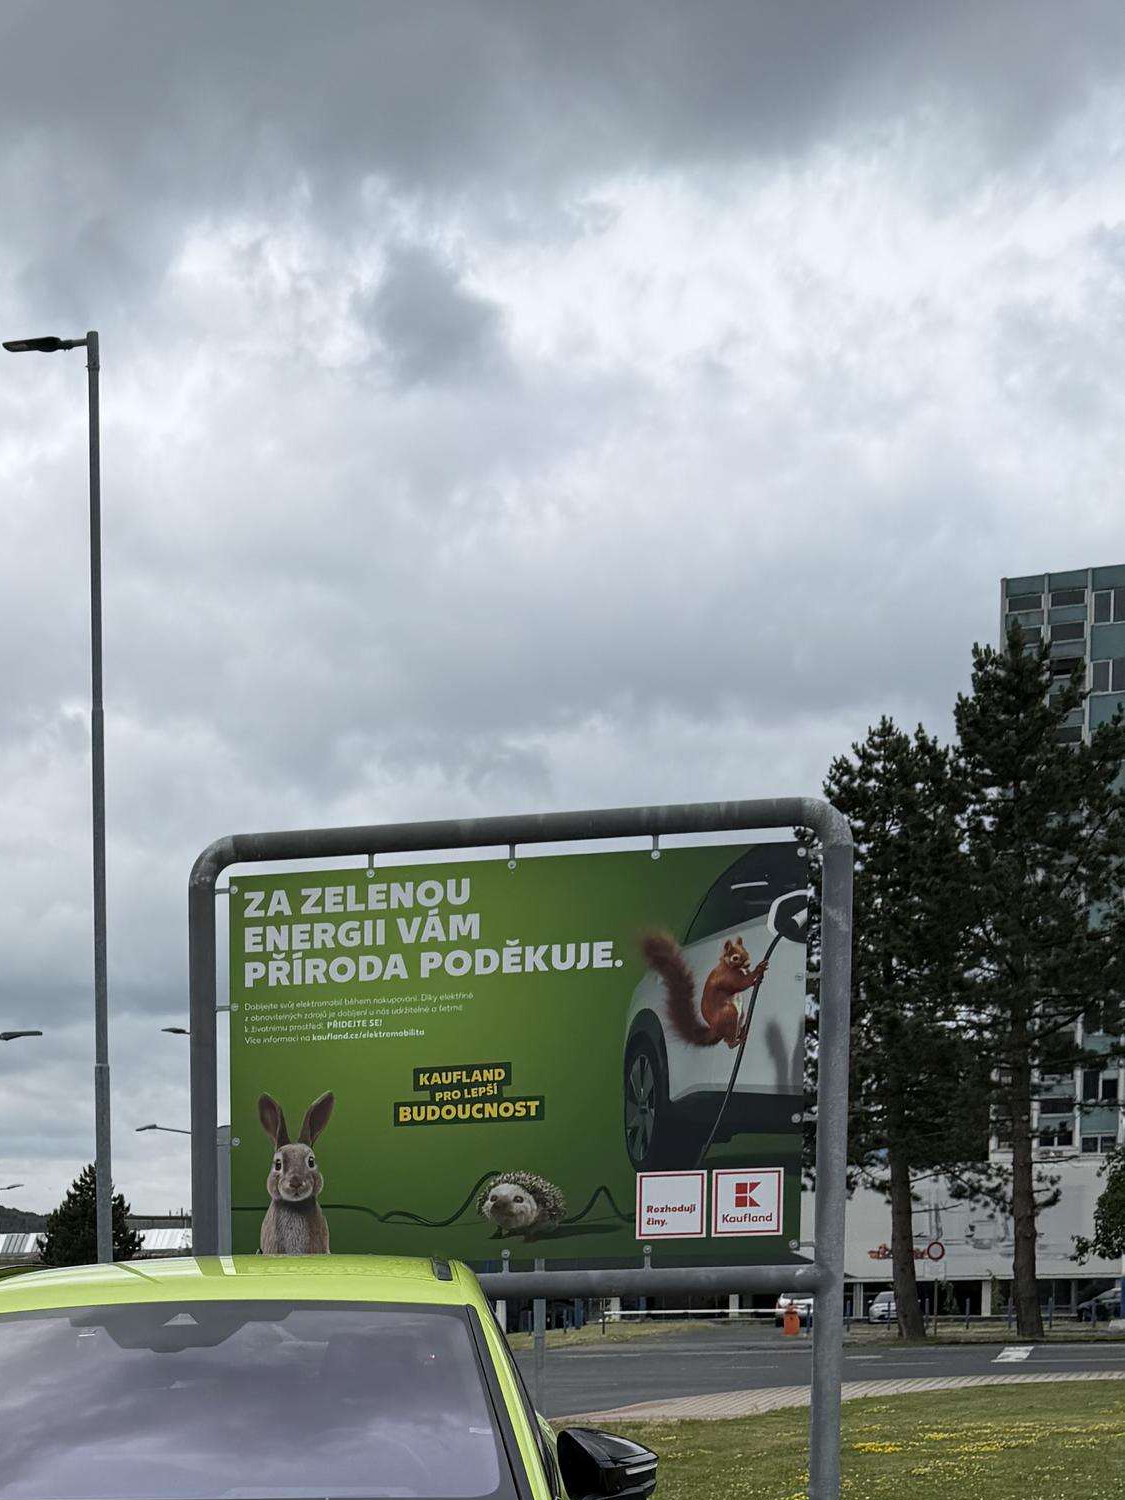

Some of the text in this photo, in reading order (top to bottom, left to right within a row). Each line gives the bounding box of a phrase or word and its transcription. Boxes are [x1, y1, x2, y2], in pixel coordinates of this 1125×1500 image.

[243, 877, 471, 918] ZA ZELENOU
[244, 908, 481, 954] ENERGII VÁM
[244, 938, 624, 988] PŘÍRODA PODĚKUJE.
[295, 998, 343, 1008] elektromobil
[328, 1011, 336, 1019] je
[327, 1017, 367, 1029] PŘIDEJTE
[368, 1018, 383, 1027] SE!
[312, 1028, 425, 1042] kaufland.cz/elektromobilita
[419, 1068, 506, 1086] KAUFLAND
[435, 1082, 498, 1102] PRO LEPŠÍ
[398, 1101, 540, 1123] BUDOUCNOST
[646, 1203, 696, 1215] Rozhodují
[646, 1217, 668, 1227] činy.
[722, 1212, 773, 1224] Kaufland
